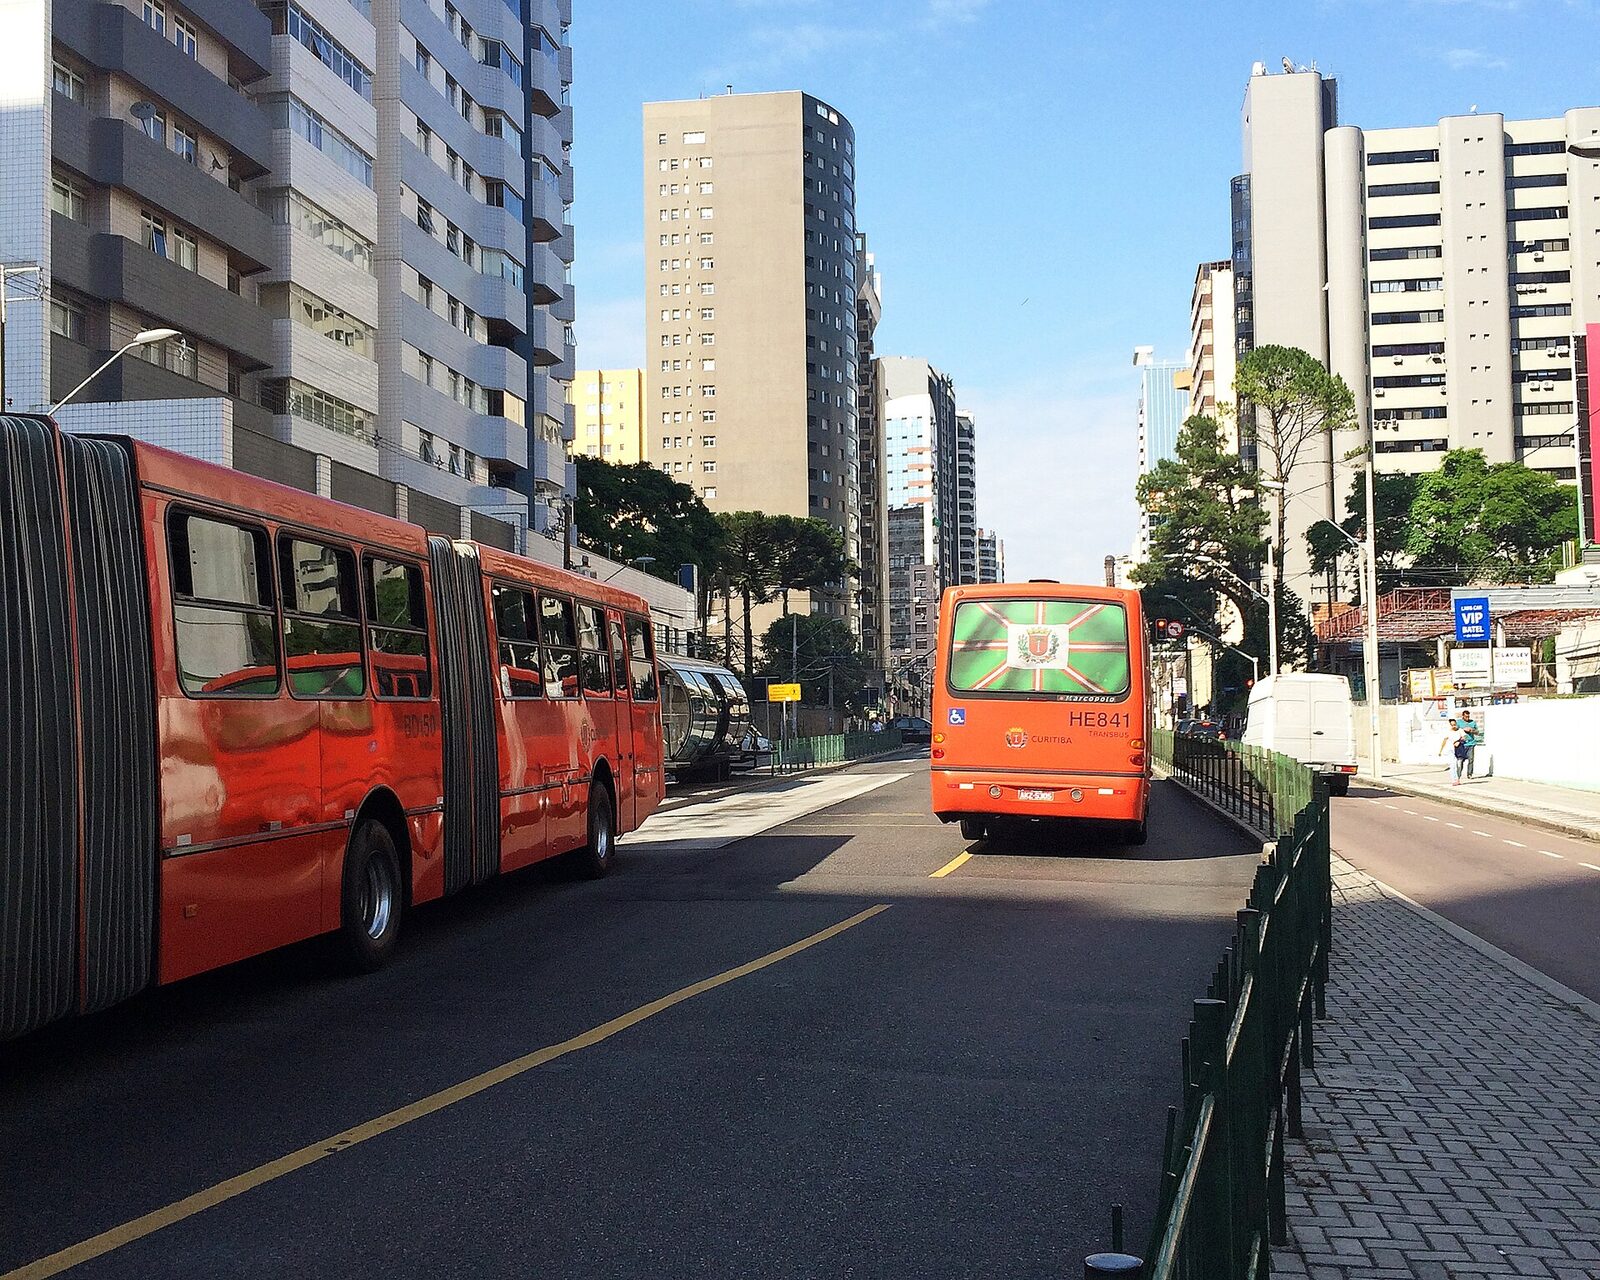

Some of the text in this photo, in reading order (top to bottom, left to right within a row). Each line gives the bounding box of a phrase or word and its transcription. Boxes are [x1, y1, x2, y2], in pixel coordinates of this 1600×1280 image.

[1462, 612, 1483, 625] VIP
[1462, 625, 1485, 634] BATEL
[1069, 711, 1130, 728] HE841
[1088, 730, 1130, 739] TRANSBUS
[1031, 735, 1073, 744] CURITIBA
